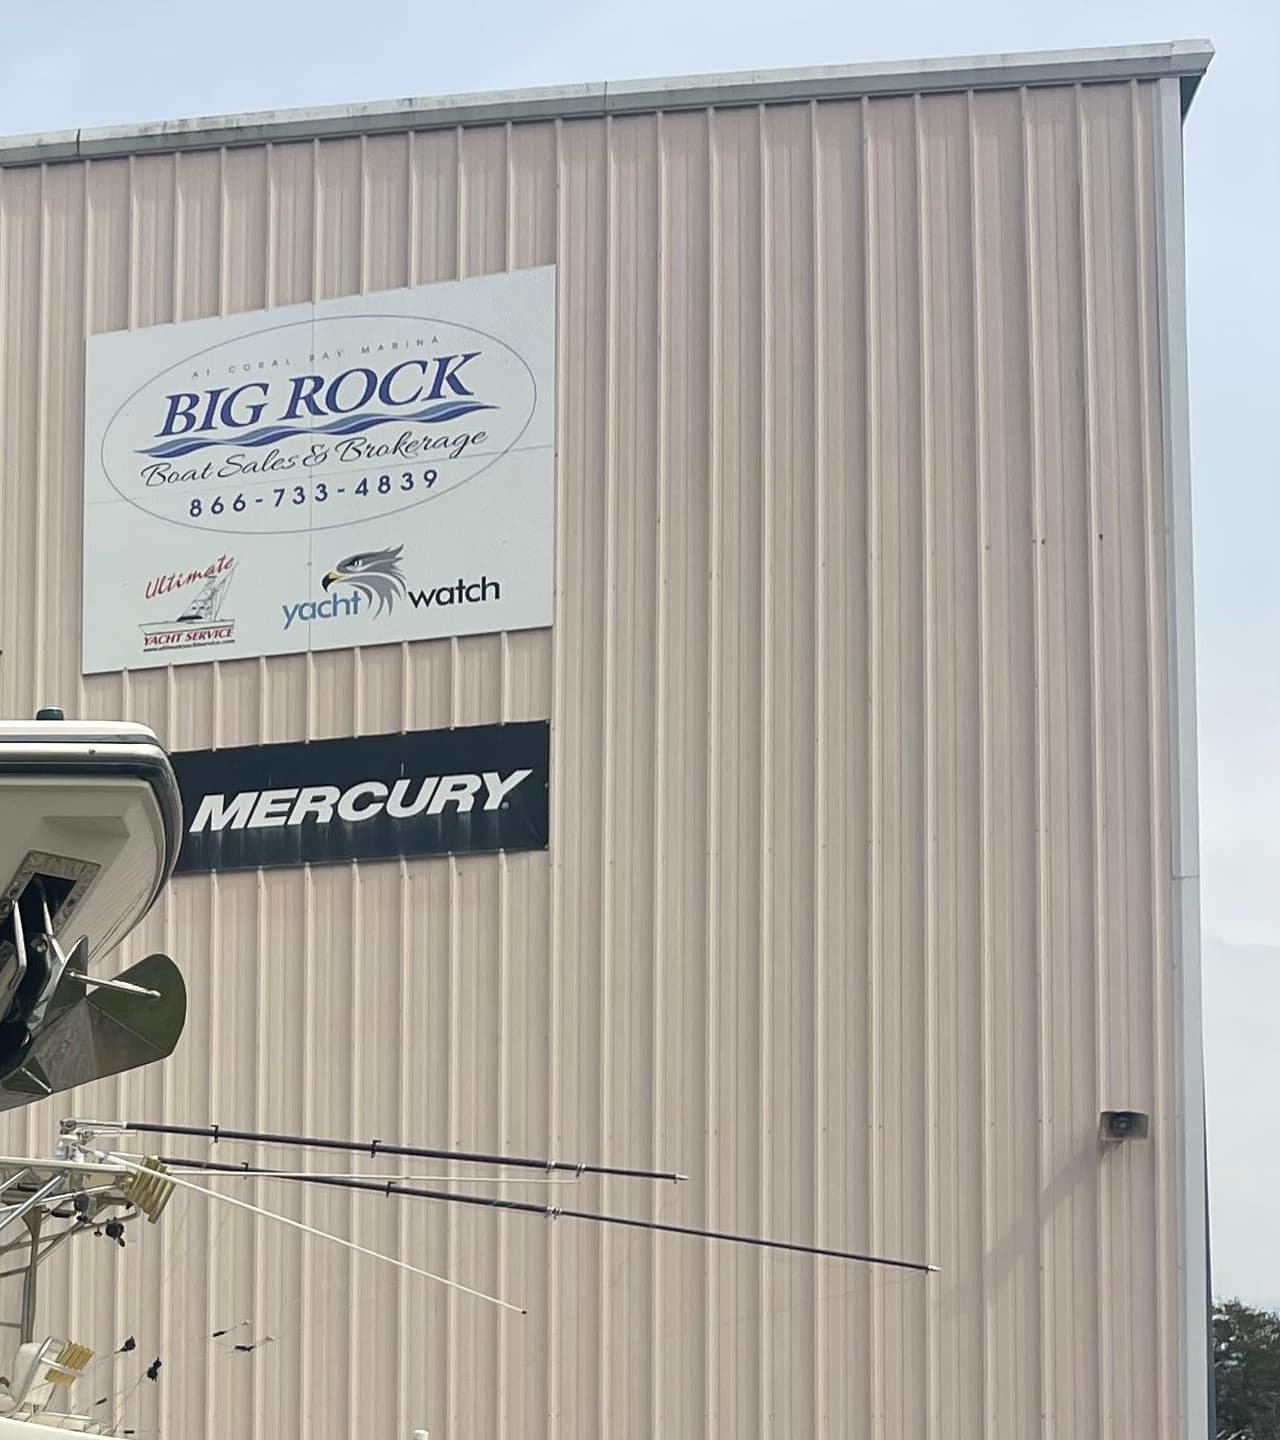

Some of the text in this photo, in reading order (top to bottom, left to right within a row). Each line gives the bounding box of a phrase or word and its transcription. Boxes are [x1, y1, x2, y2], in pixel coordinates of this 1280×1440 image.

[361, 336, 440, 354] MARINA
[154, 351, 482, 437] BIG ROCK
[141, 430, 489, 487] Boat Sales & Brokerage
[189, 468, 438, 518] 866-733-4839
[145, 554, 234, 600] Ultimate
[282, 576, 500, 630] yacht watch
[144, 633, 183, 646] YACHT
[185, 628, 234, 641] SERVICE
[189, 769, 533, 833] MERCURY
